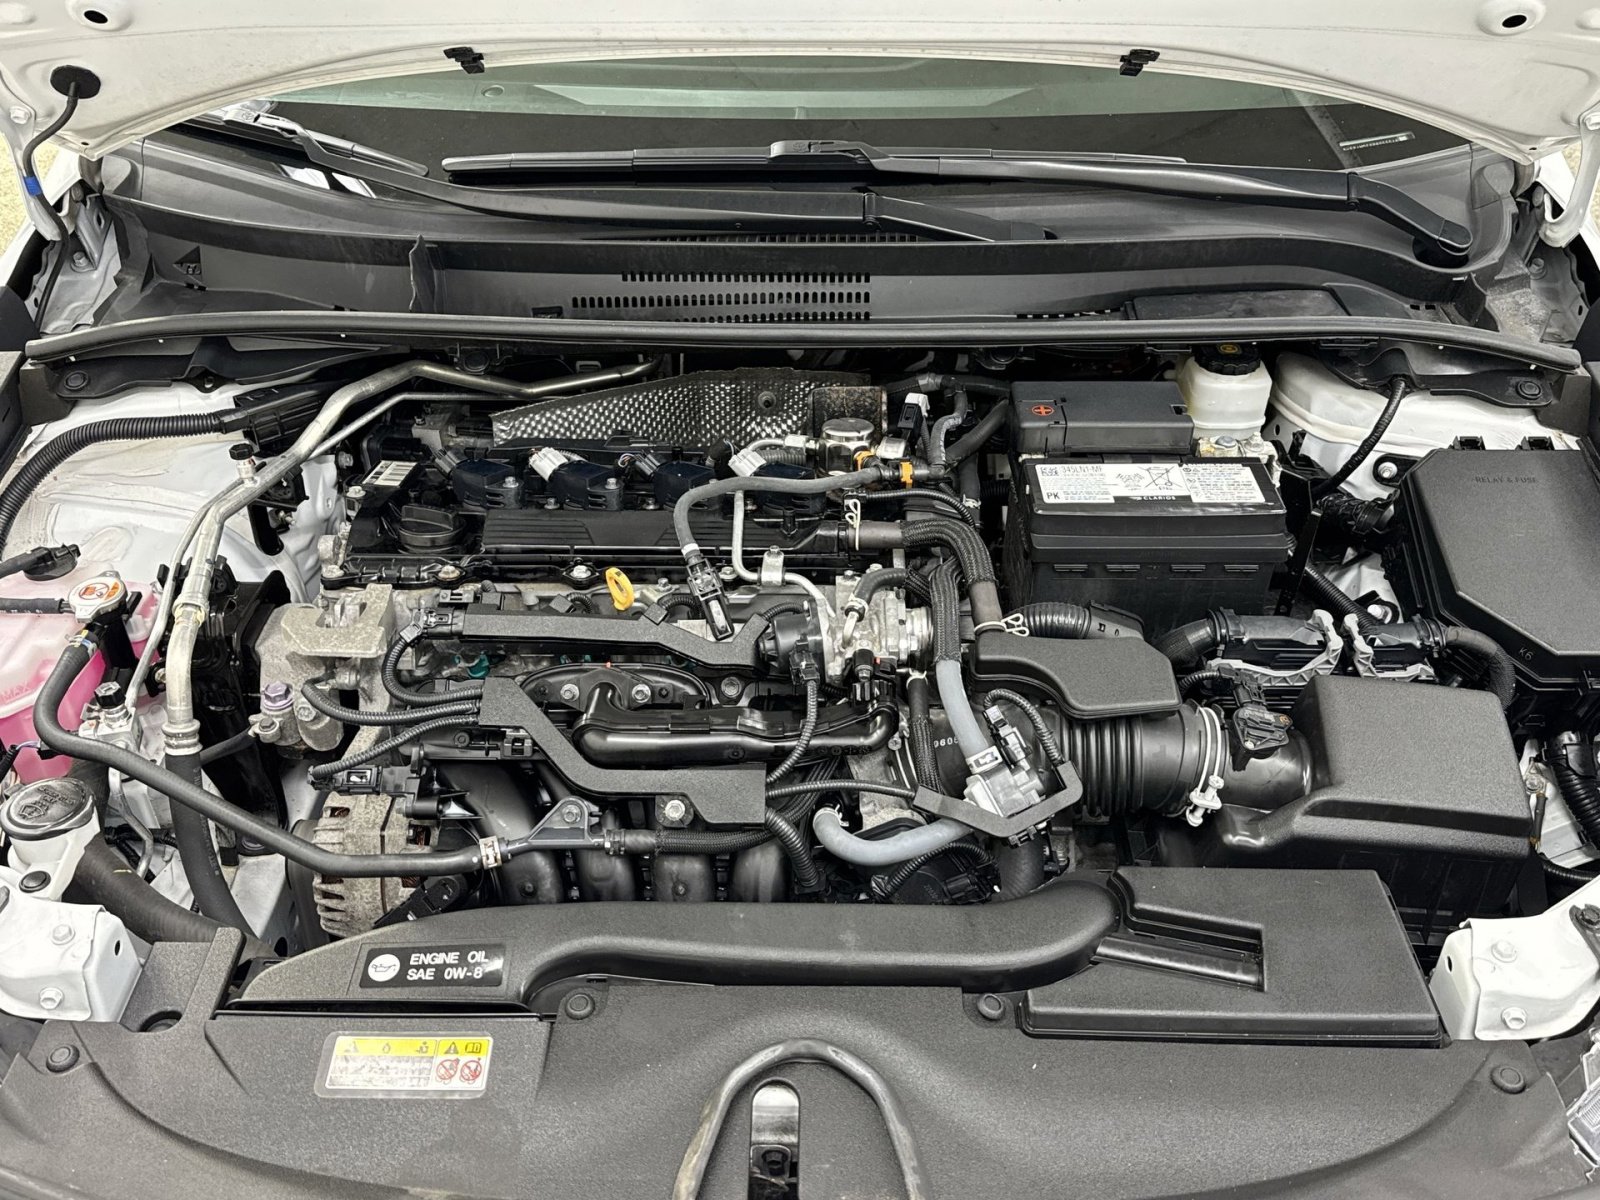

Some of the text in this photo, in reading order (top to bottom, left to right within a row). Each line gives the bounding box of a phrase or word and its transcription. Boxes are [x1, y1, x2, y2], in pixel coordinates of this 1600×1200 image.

[1046, 492, 1060, 500] PK
[409, 950, 490, 965] ENGINE OIL
[406, 966, 484, 981] SAE 0W-8
